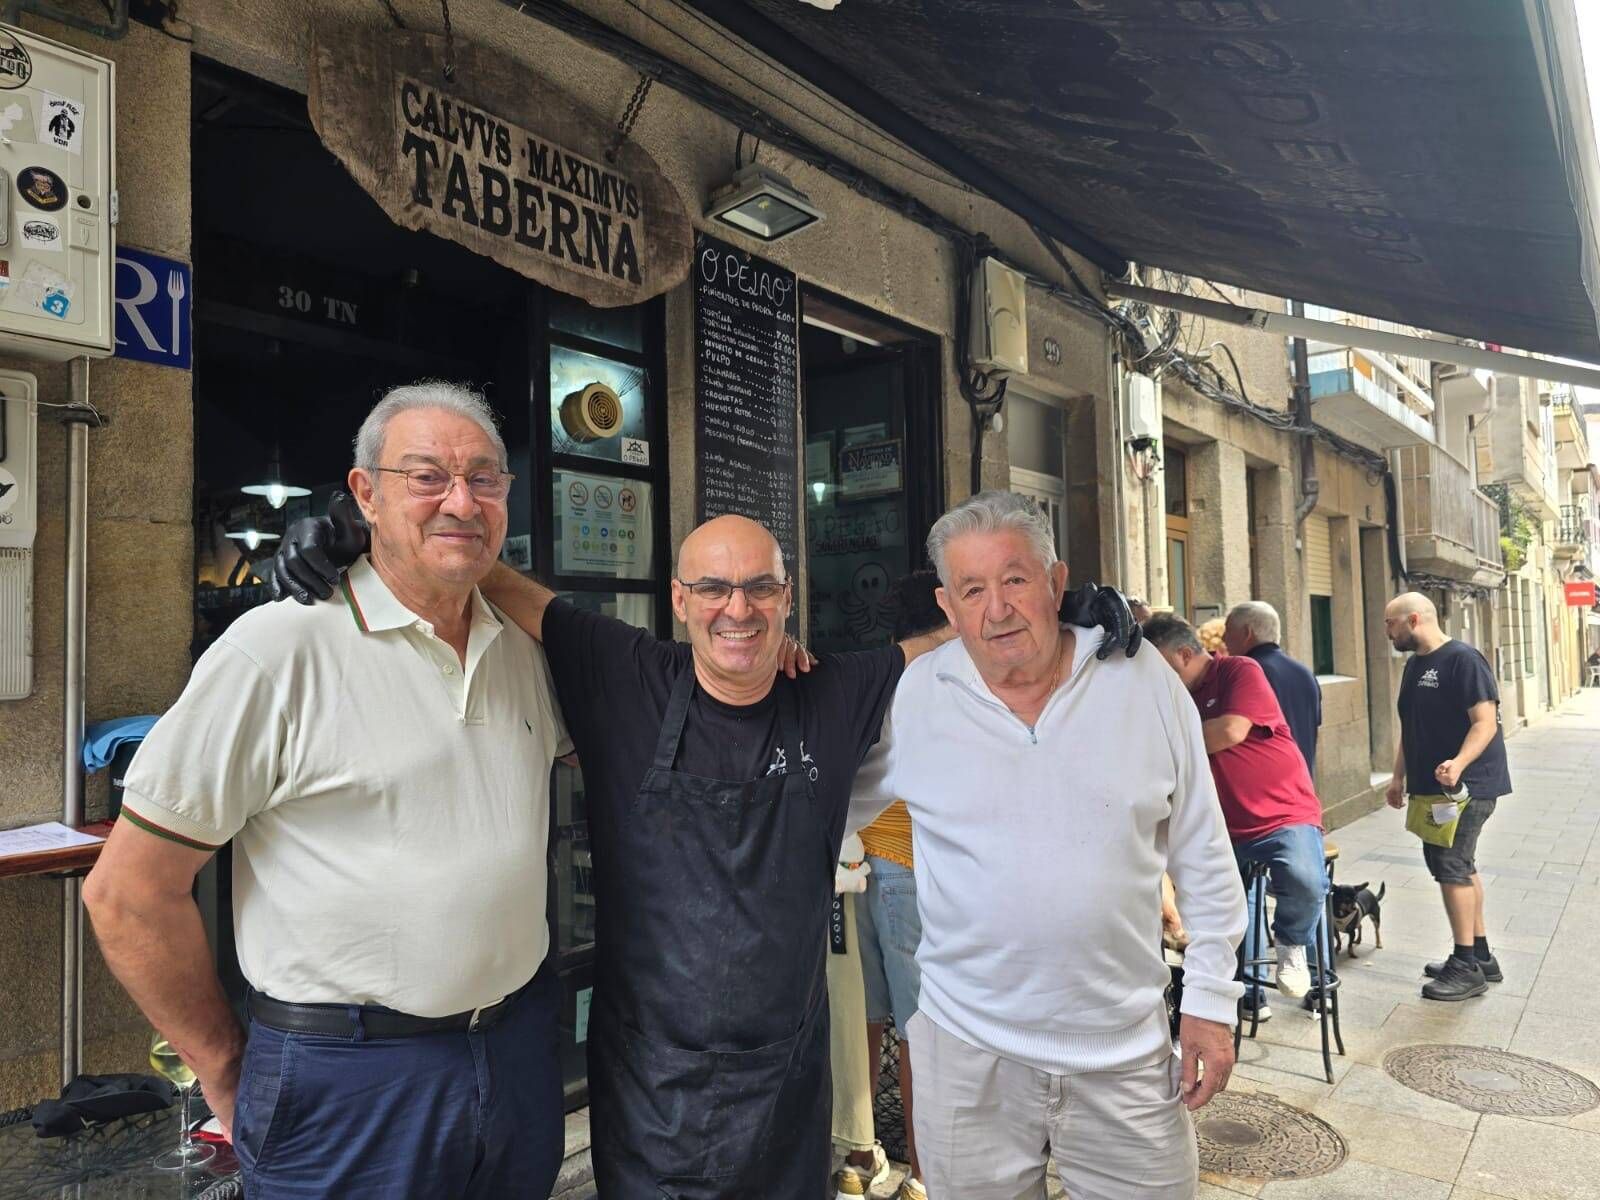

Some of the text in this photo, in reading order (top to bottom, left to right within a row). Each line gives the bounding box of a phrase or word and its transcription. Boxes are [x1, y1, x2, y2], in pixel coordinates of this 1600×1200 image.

[401, 81, 512, 168] CALVVS
[401, 131, 643, 286] TABERNA
[701, 248, 721, 283] O
[115, 257, 168, 353] R
[278, 285, 358, 325] 30 TN
[704, 389, 743, 405] CROQUETAS
[705, 401, 732, 414] HUEVOS
